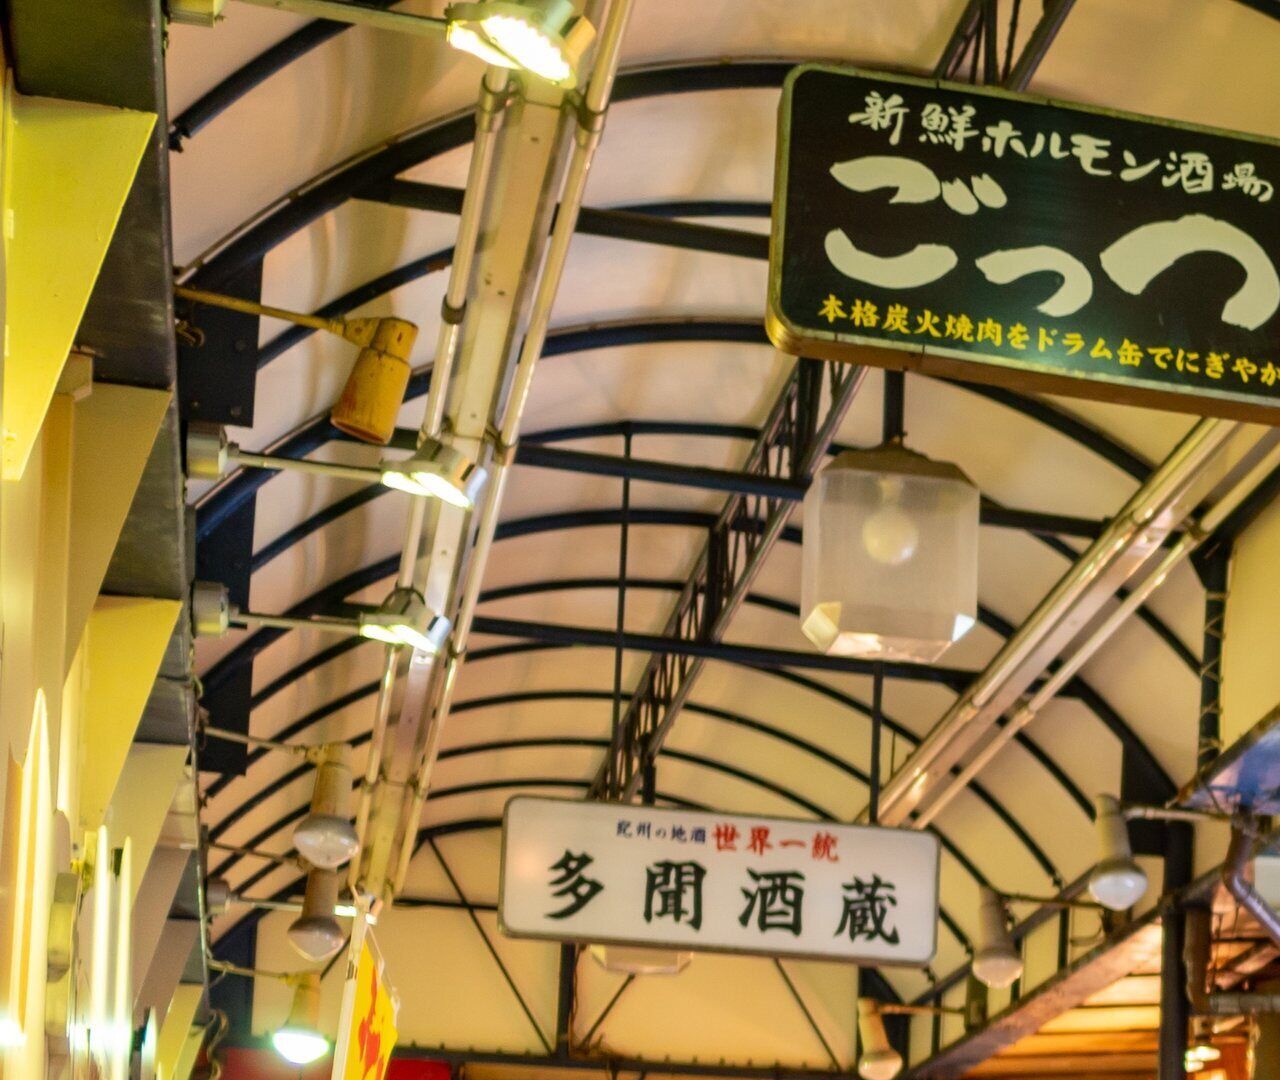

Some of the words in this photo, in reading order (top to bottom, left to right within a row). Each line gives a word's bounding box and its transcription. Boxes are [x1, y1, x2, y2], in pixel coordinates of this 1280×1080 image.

[849, 91, 1273, 202] 新鮮ホルモン酒場
[711, 823, 840, 862] 世界一統
[545, 848, 900, 945] 多聞酒蔵
